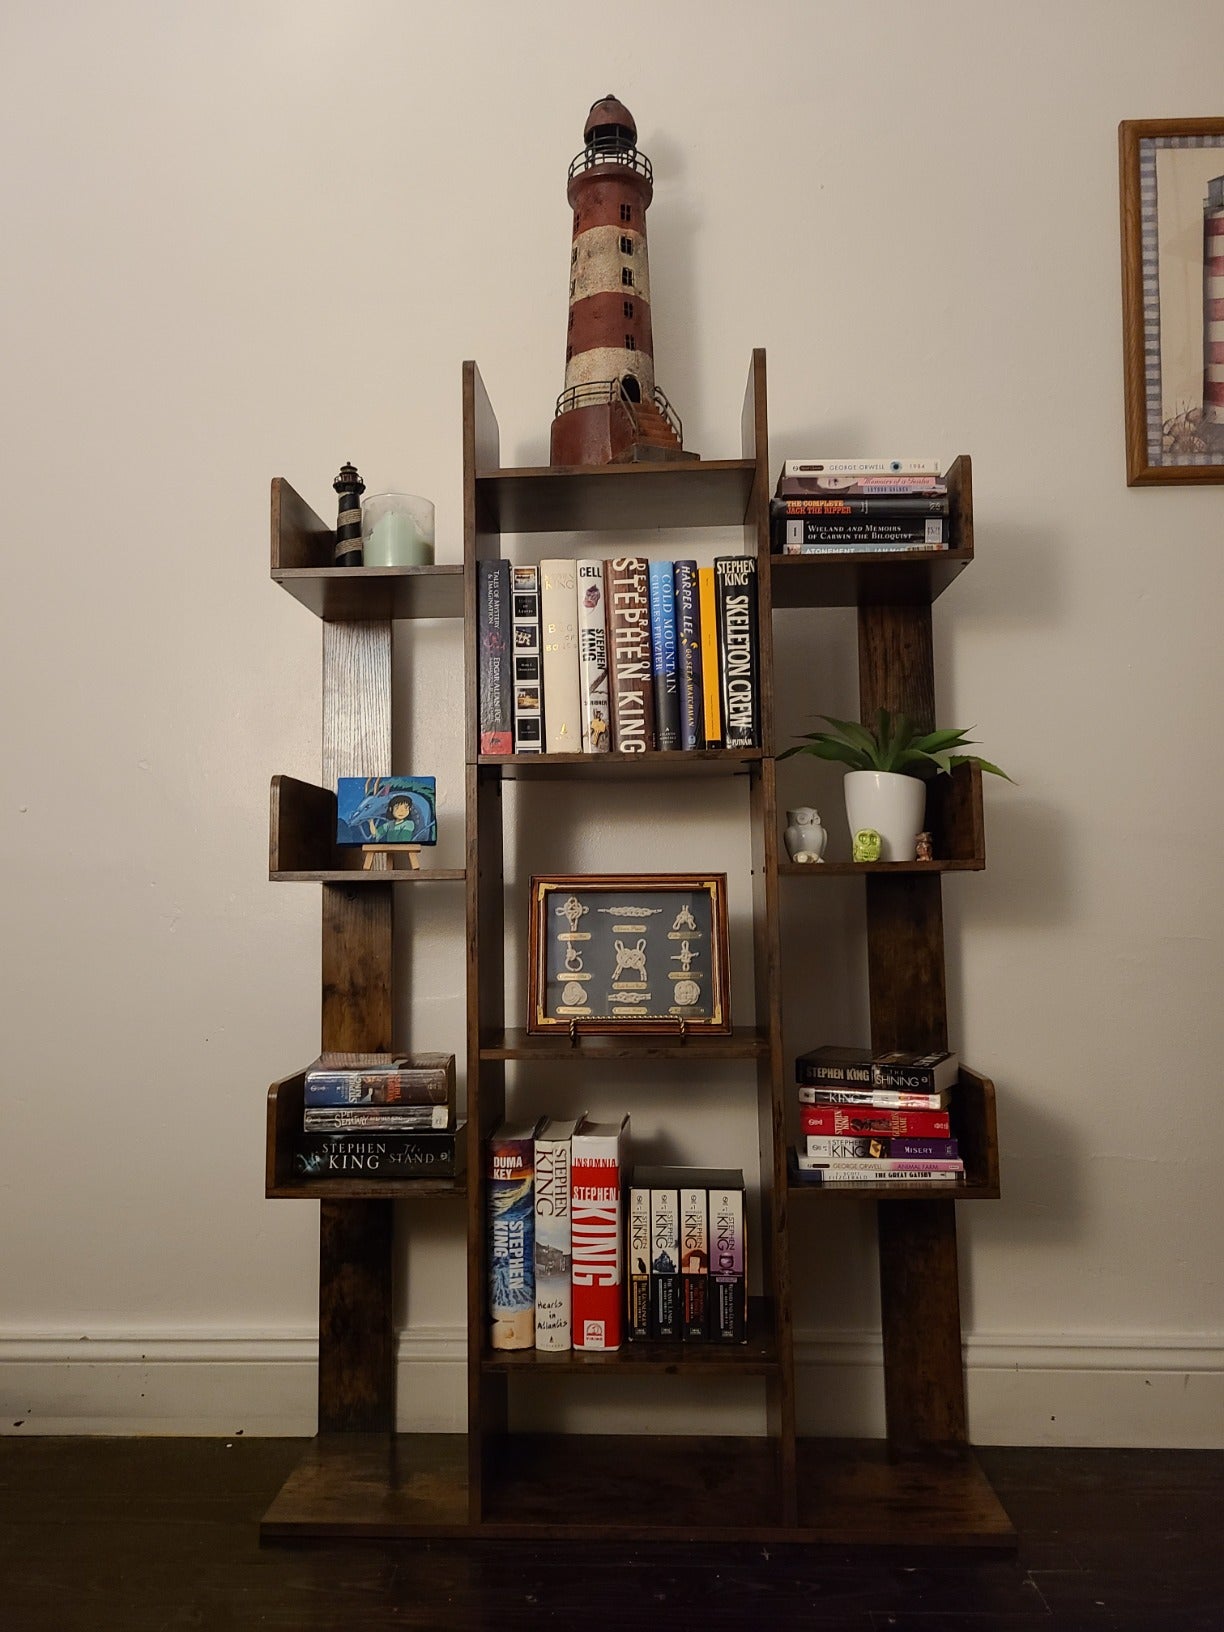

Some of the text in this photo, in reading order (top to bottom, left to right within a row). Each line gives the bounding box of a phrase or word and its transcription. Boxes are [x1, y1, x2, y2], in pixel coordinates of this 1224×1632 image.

[786, 506, 806, 514] JACK
[807, 506, 823, 514] THE
[824, 506, 852, 514] RIPPER
[579, 567, 602, 578] CELL
[716, 559, 756, 575] STEPHEN
[724, 572, 749, 586] KING
[681, 565, 693, 635] HARPER LEE
[636, 563, 651, 681] DESPERATION
[652, 574, 663, 670] CHARLES FRAZIER
[661, 574, 677, 694] COLD MOUNTAIN
[595, 628, 606, 670] STEPHEN
[612, 557, 646, 753] STEPHEN KING
[685, 648, 692, 660] GO
[493, 657, 501, 682] EDGAR
[725, 595, 753, 728] SKELETON CREW
[687, 684, 695, 727] WATCHMAN
[494, 708, 502, 723] POE
[806, 1066, 870, 1082] STEPHEN KING
[875, 1074, 920, 1087] SHINING
[322, 1143, 386, 1154] STEPHEN
[831, 1145, 866, 1158] KING
[328, 1155, 380, 1170] KING
[389, 1153, 435, 1164] STAND
[493, 1156, 523, 1168] DUMA
[573, 1157, 617, 1168] INSOMNIA
[493, 1168, 512, 1180] KEY
[535, 1149, 555, 1217] KING
[554, 1148, 567, 1218] STEPHEN
[573, 1186, 617, 1202] STEPHEN
[494, 1220, 509, 1258] KING
[632, 1215, 643, 1250] KING
[655, 1214, 668, 1249] KING
[685, 1214, 697, 1249] KING
[716, 1216, 730, 1251] KING
[571, 1206, 620, 1287] KING
[508, 1220, 525, 1290] STEPHEN
[537, 1299, 563, 1309] Hearts
[549, 1311, 556, 1319] in
[537, 1319, 568, 1330] Atlantis
